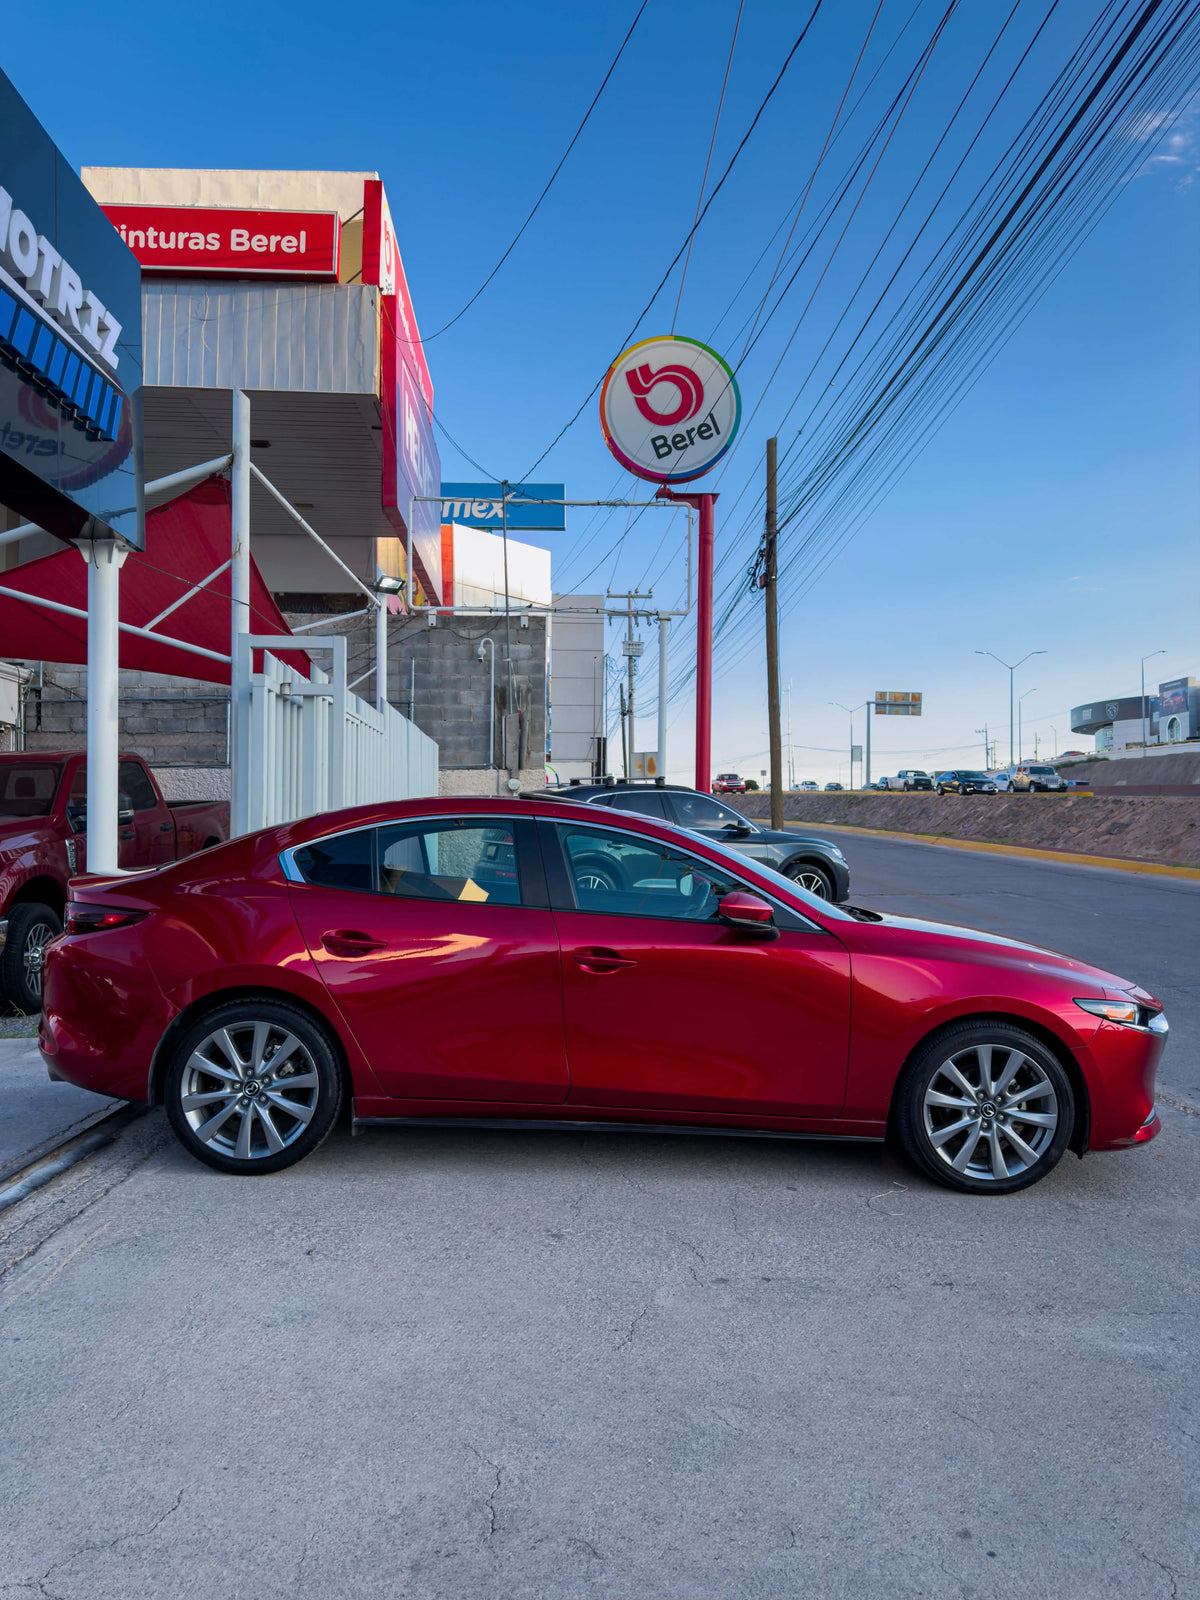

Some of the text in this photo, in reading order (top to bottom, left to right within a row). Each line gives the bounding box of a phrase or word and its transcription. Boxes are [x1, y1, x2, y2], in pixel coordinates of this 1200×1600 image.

[114, 224, 306, 253] inturas Berel
[651, 412, 721, 459] Berel
[440, 491, 517, 519] mex
